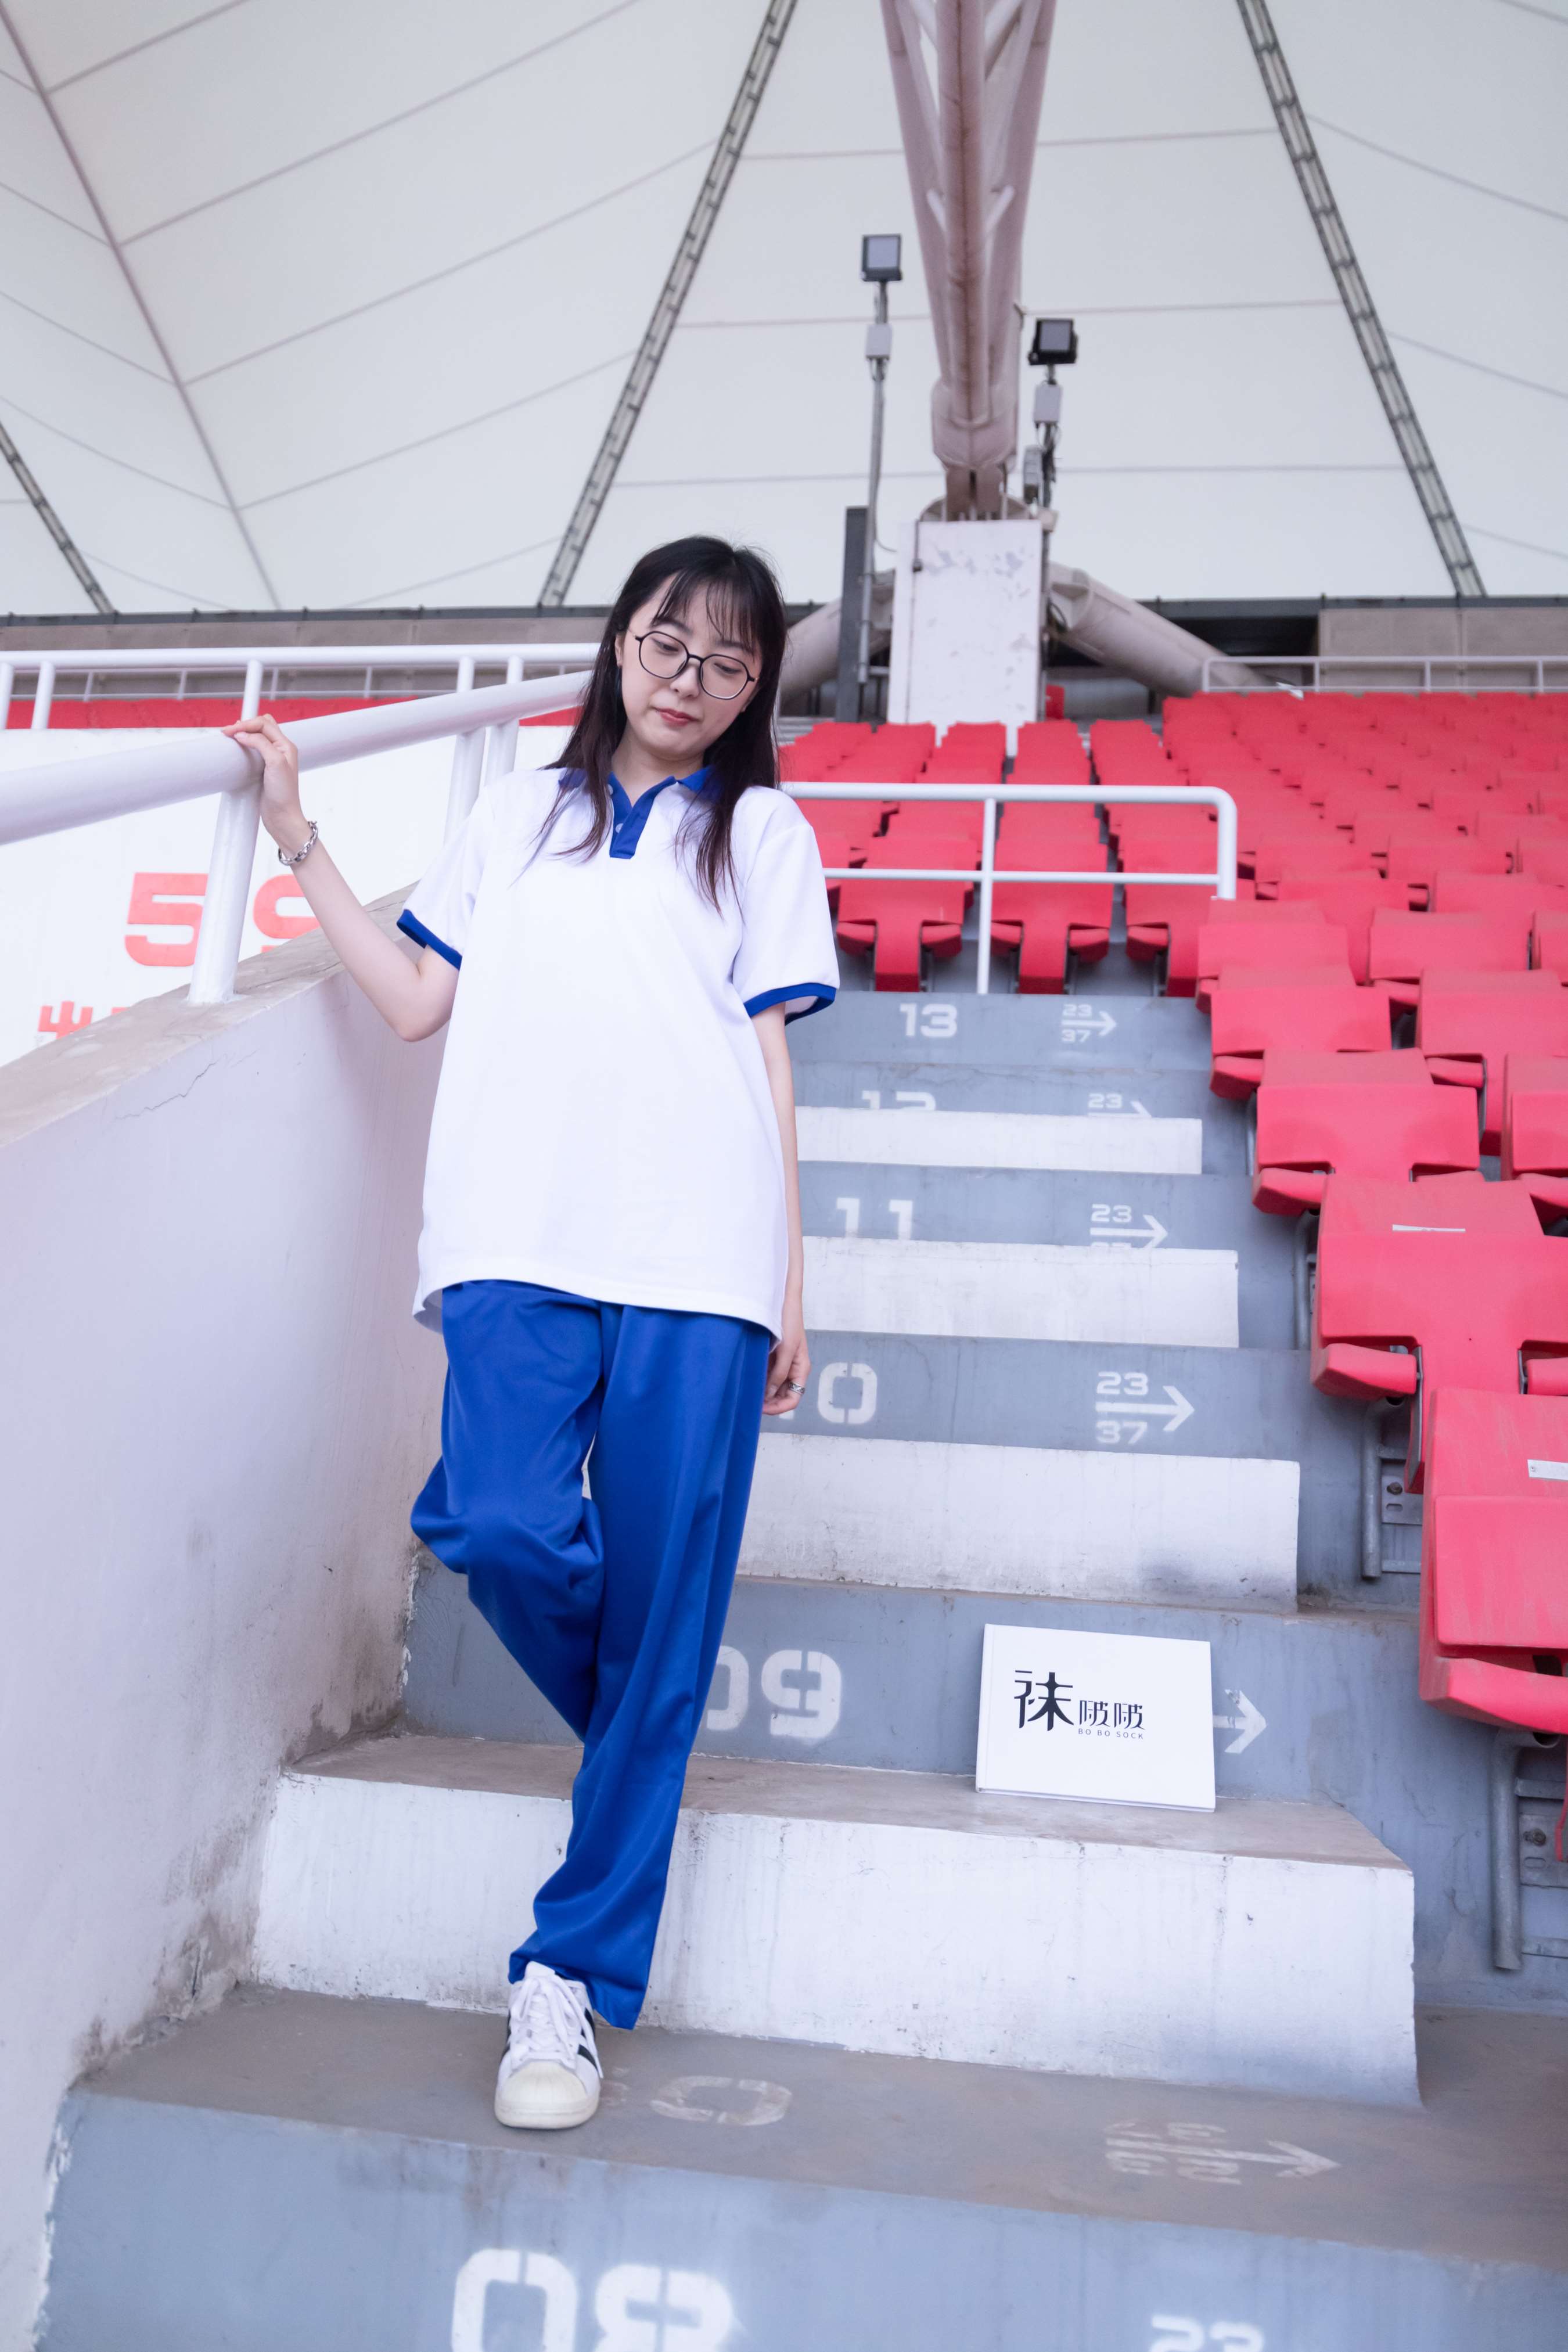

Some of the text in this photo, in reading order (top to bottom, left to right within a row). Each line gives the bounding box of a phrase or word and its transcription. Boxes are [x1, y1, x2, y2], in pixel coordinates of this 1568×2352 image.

[901, 1003, 958, 1037] 13
[1063, 1004, 1092, 1017] 23
[1062, 1029, 1091, 1043] 37
[1088, 1093, 1122, 1109] 23
[837, 1197, 912, 1240] 11
[1091, 1203, 1132, 1222] 23
[1096, 1371, 1148, 1396] 23
[1096, 1421, 1148, 1444] 37
[1116, 1731, 1143, 1739] SOCK
